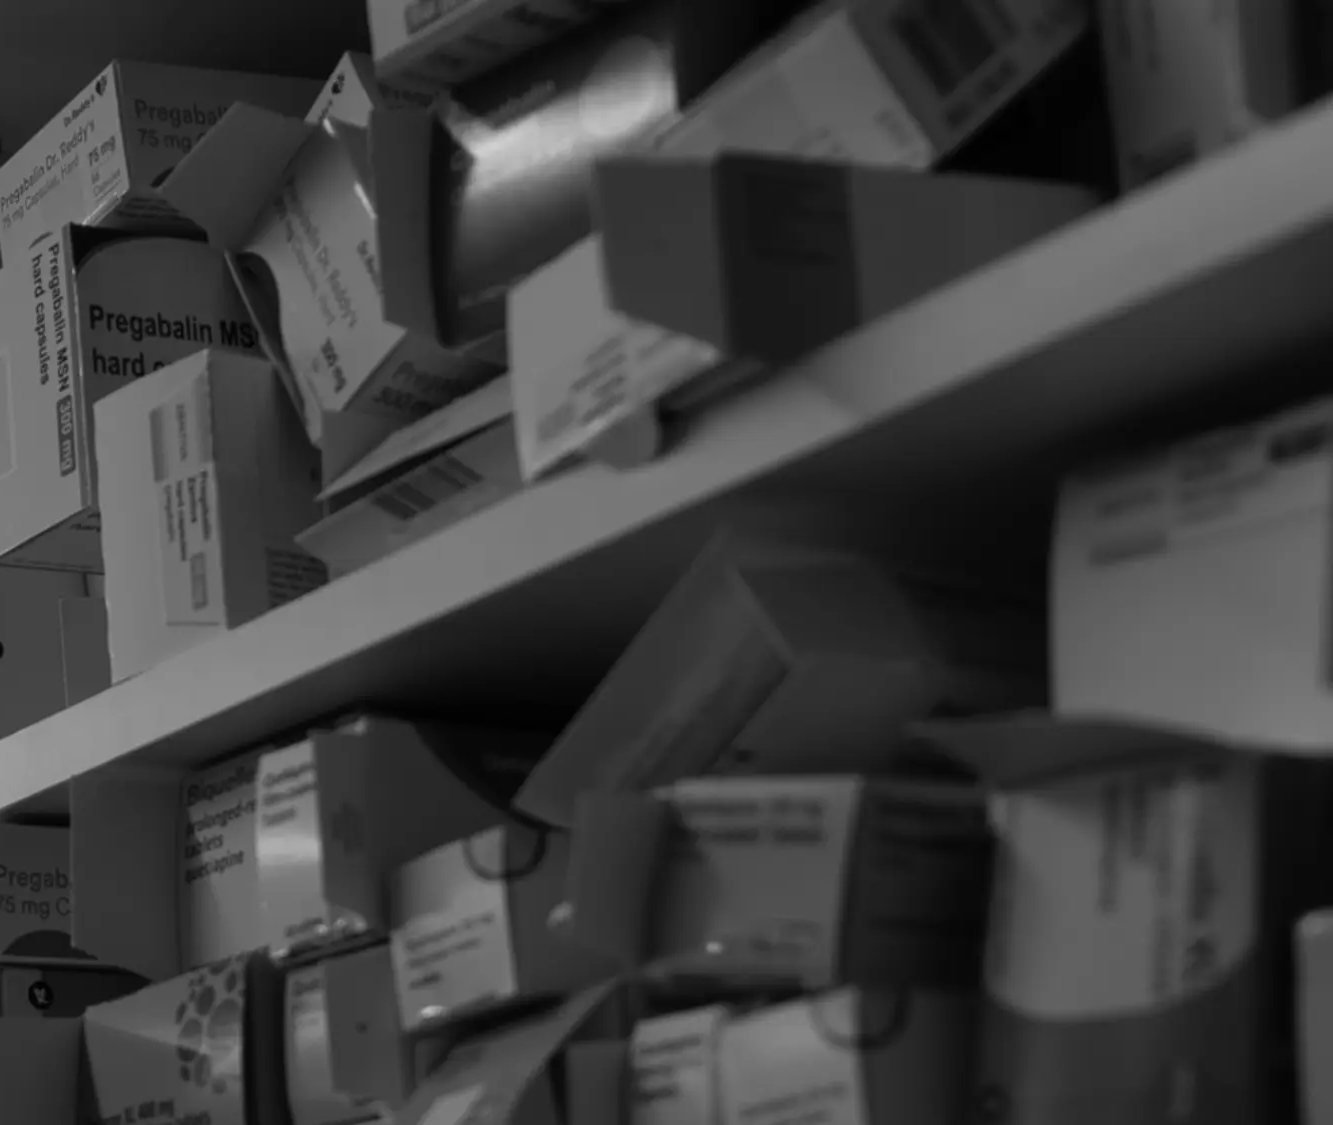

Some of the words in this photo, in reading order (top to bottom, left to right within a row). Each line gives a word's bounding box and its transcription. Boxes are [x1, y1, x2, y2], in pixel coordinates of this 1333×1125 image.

[137, 128, 159, 149] 75
[163, 134, 191, 152] mg
[0, 164, 45, 213] Pregabalin
[60, 118, 96, 159] Reddy's
[31, 252, 45, 299] hard
[48, 243, 69, 346] Pregabalin
[34, 301, 50, 387] capsules
[89, 303, 212, 344] Pregabalin
[56, 347, 70, 393] MSN
[93, 348, 145, 378] hard
[59, 401, 73, 435] 300
[61, 440, 75, 470] mg
[21, 899, 50, 921] mg
